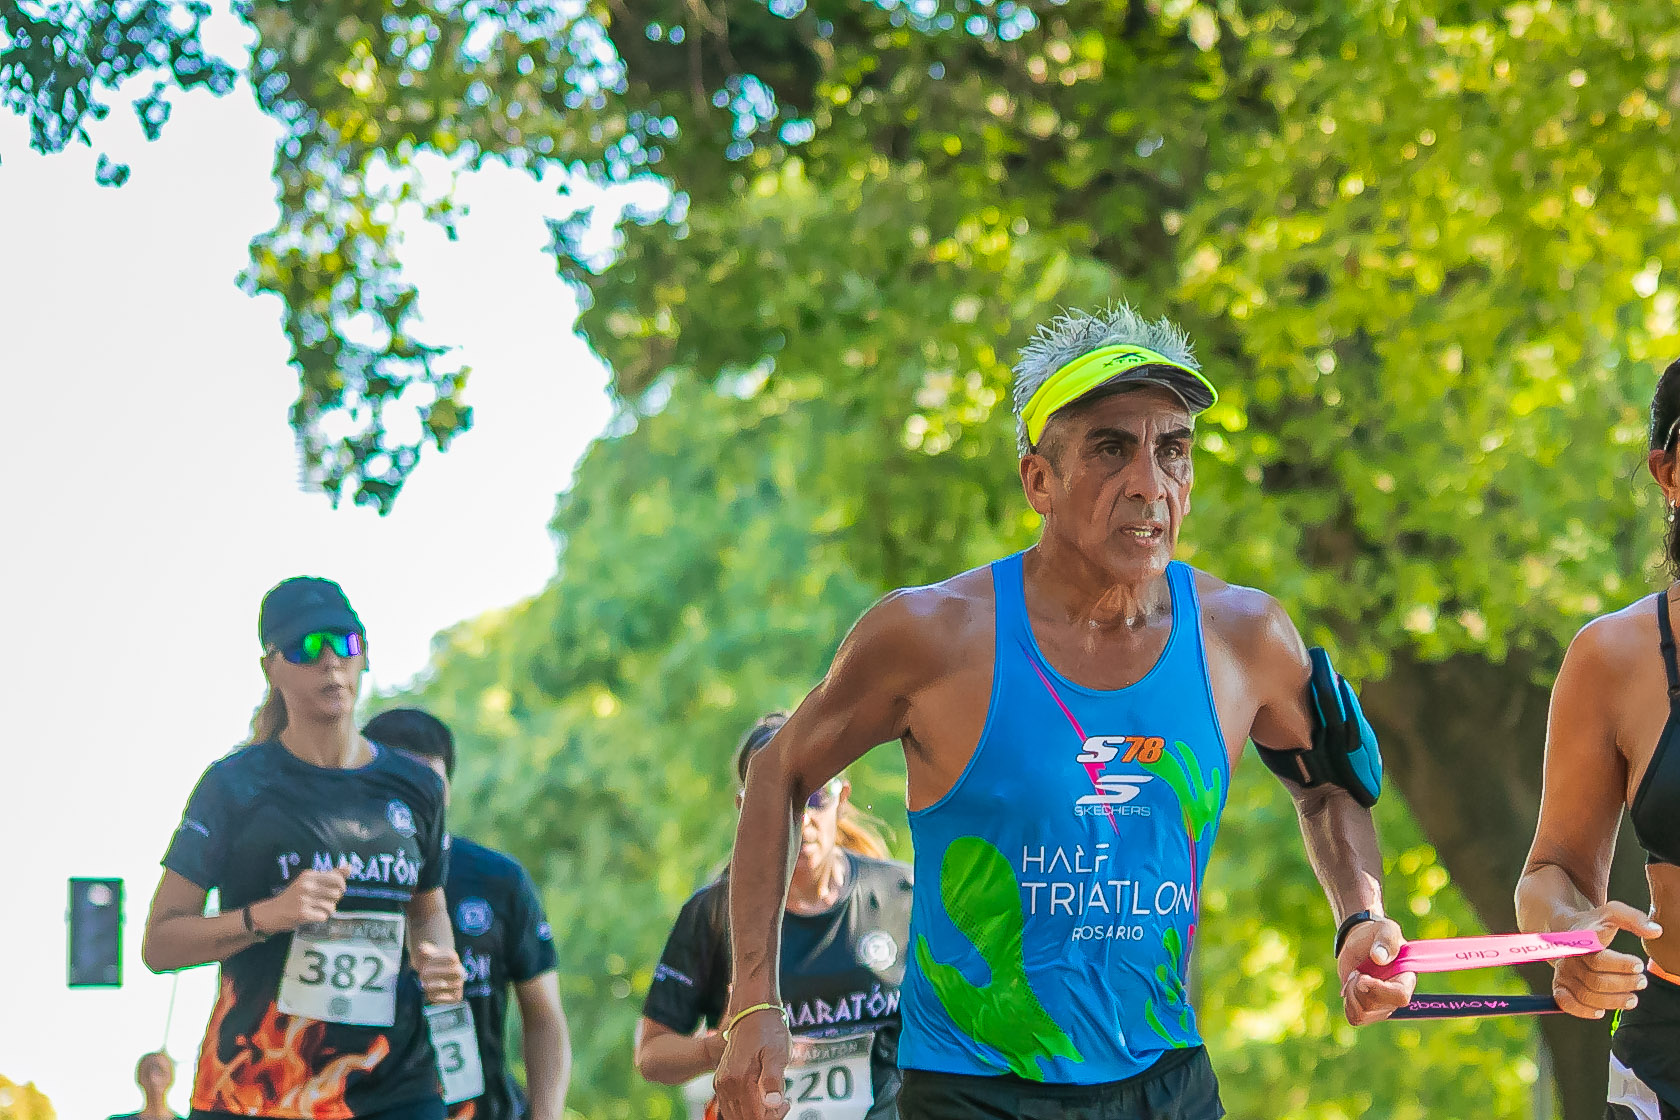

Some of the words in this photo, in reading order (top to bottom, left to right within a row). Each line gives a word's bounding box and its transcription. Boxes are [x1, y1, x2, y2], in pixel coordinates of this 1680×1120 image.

[1076, 735, 1166, 764] S78
[1074, 805, 1151, 817] SKECHERS
[312, 849, 421, 886] MARATÓN
[1023, 843, 1110, 873] HALF
[1021, 880, 1194, 916] TRIATLON
[1071, 925, 1144, 942] ROSARIO
[1455, 950, 1499, 961] Club
[299, 949, 384, 993] 382
